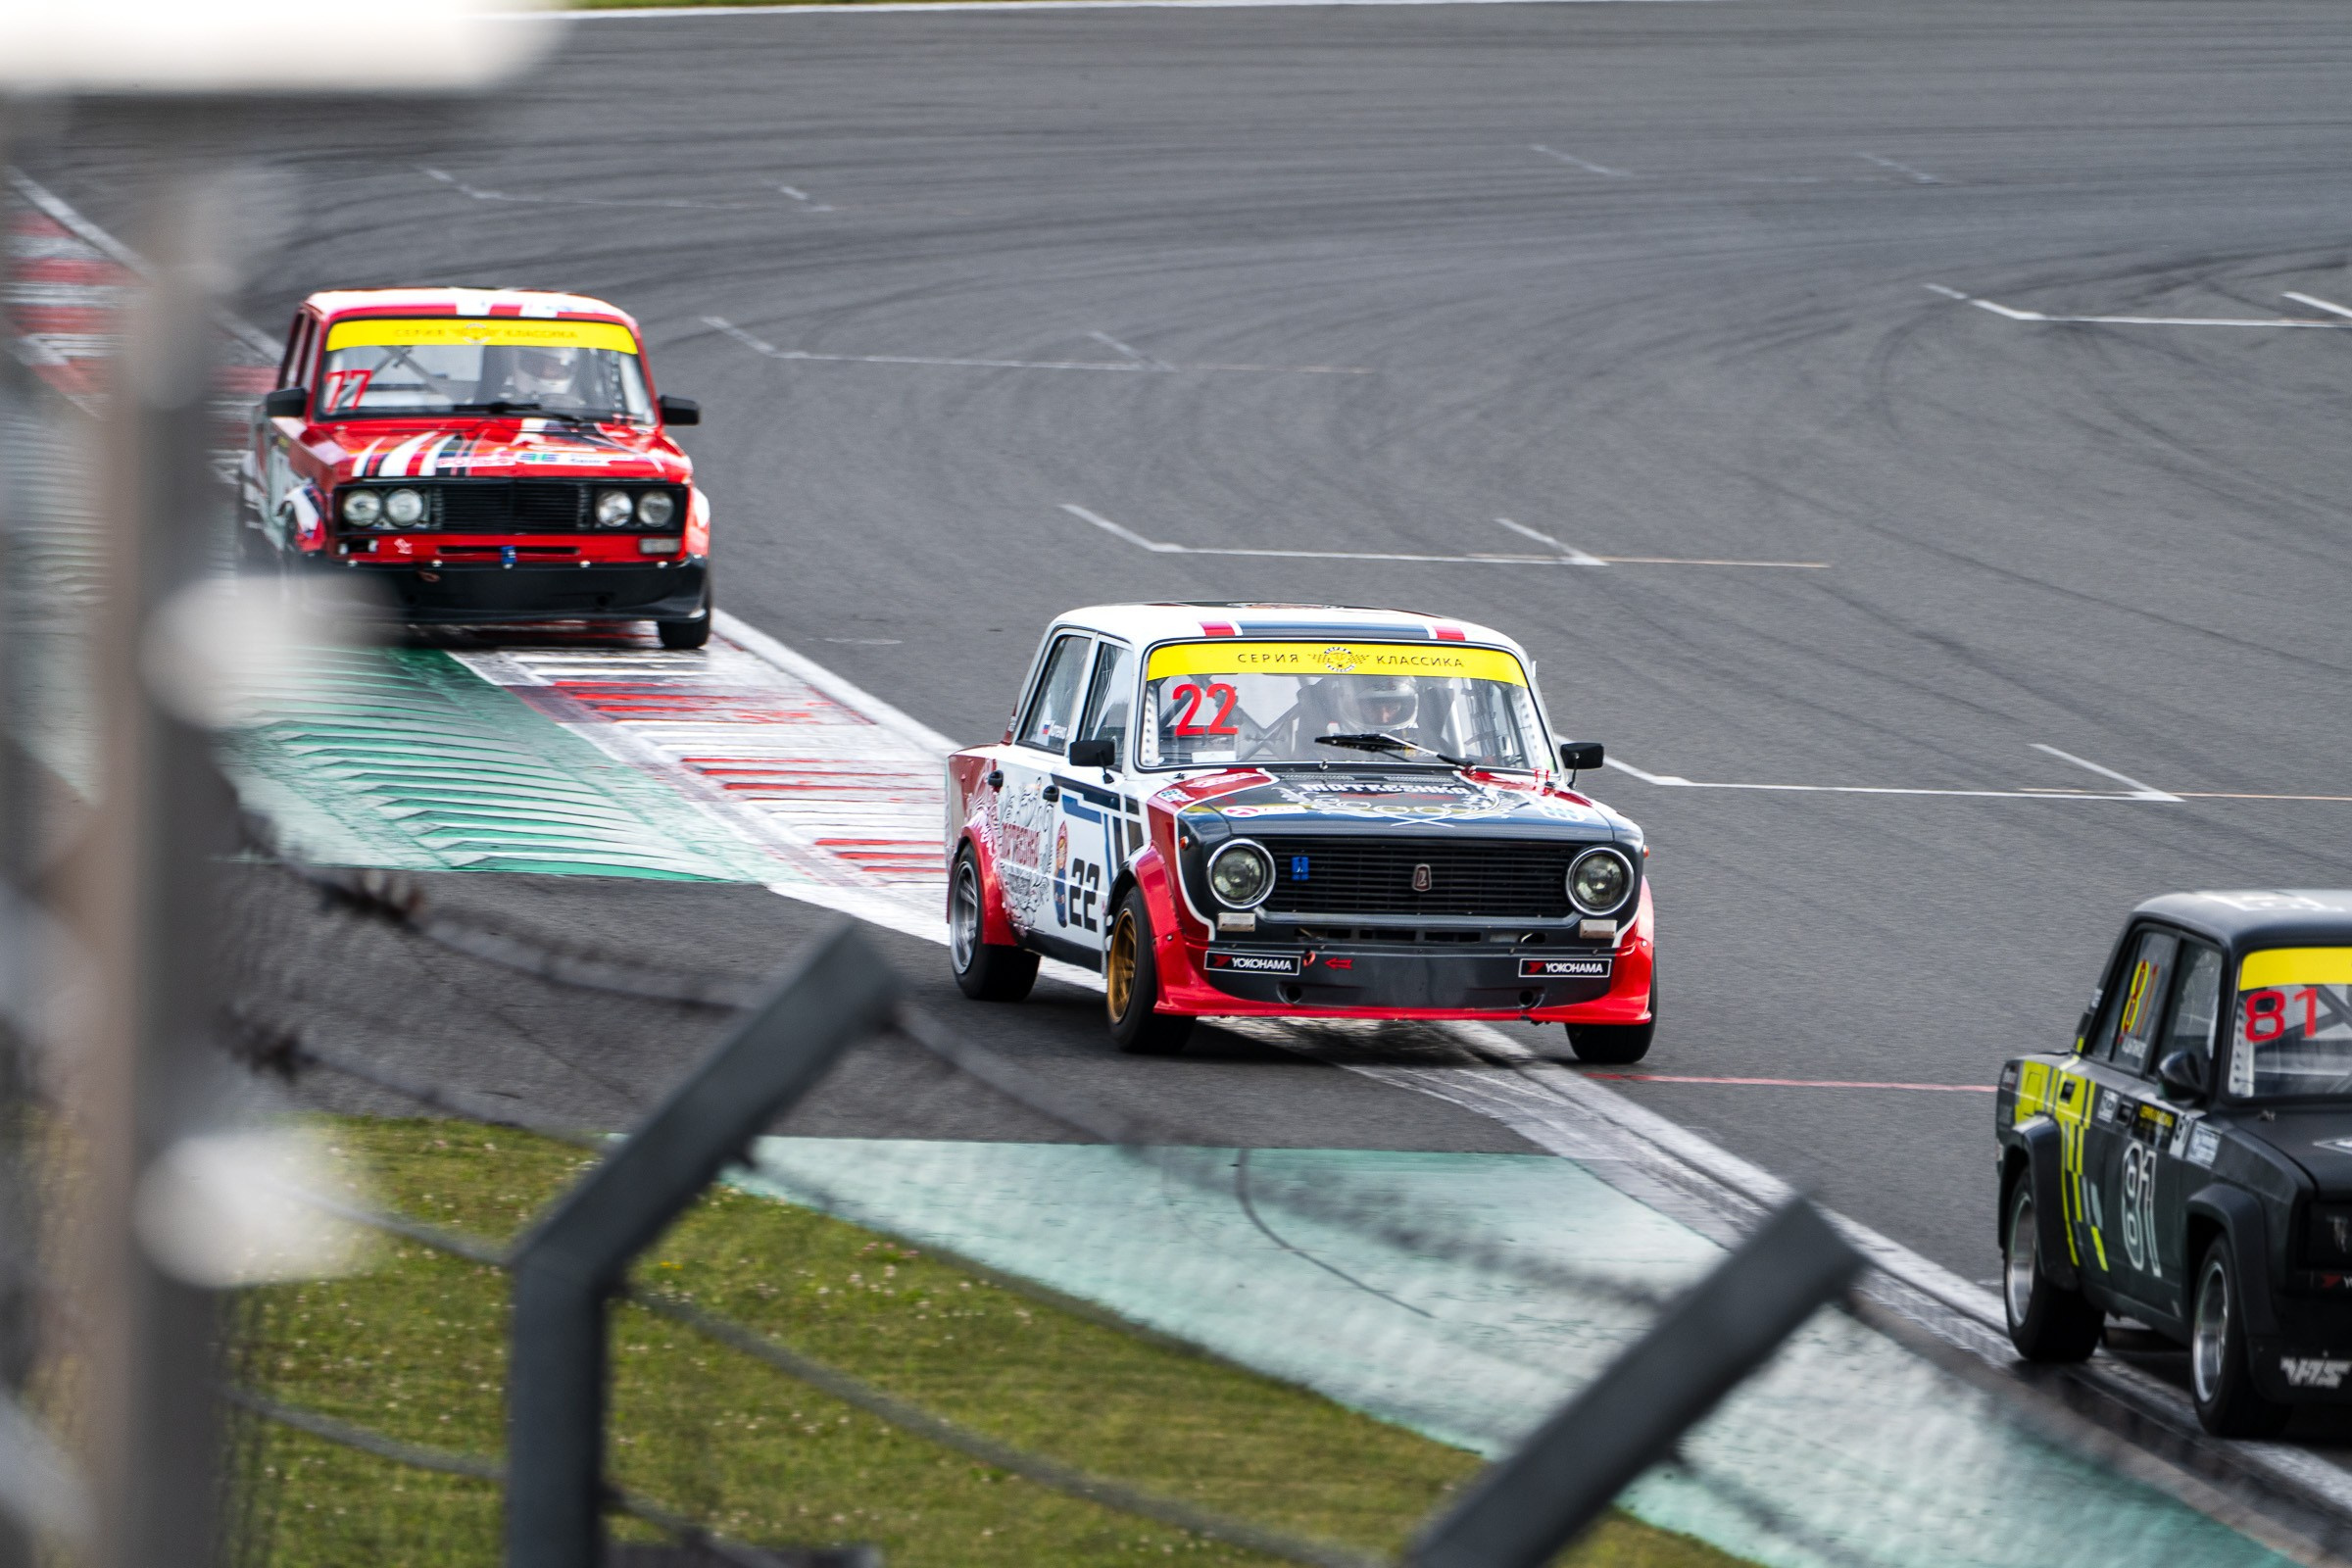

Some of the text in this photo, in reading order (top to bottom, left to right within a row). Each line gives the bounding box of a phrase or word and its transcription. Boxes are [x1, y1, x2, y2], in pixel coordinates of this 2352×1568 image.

[1237, 653, 1466, 668] СЕРИЯ КЛАССИКА
[1172, 683, 1239, 737] 22
[1069, 858, 1101, 932] 22
[1232, 956, 1293, 971] YOKOHAMA
[1545, 962, 1603, 974] YOKOHAMA
[2121, 959, 2159, 1039] 81
[2244, 987, 2319, 1044] 81
[2121, 1141, 2162, 1277] 81
